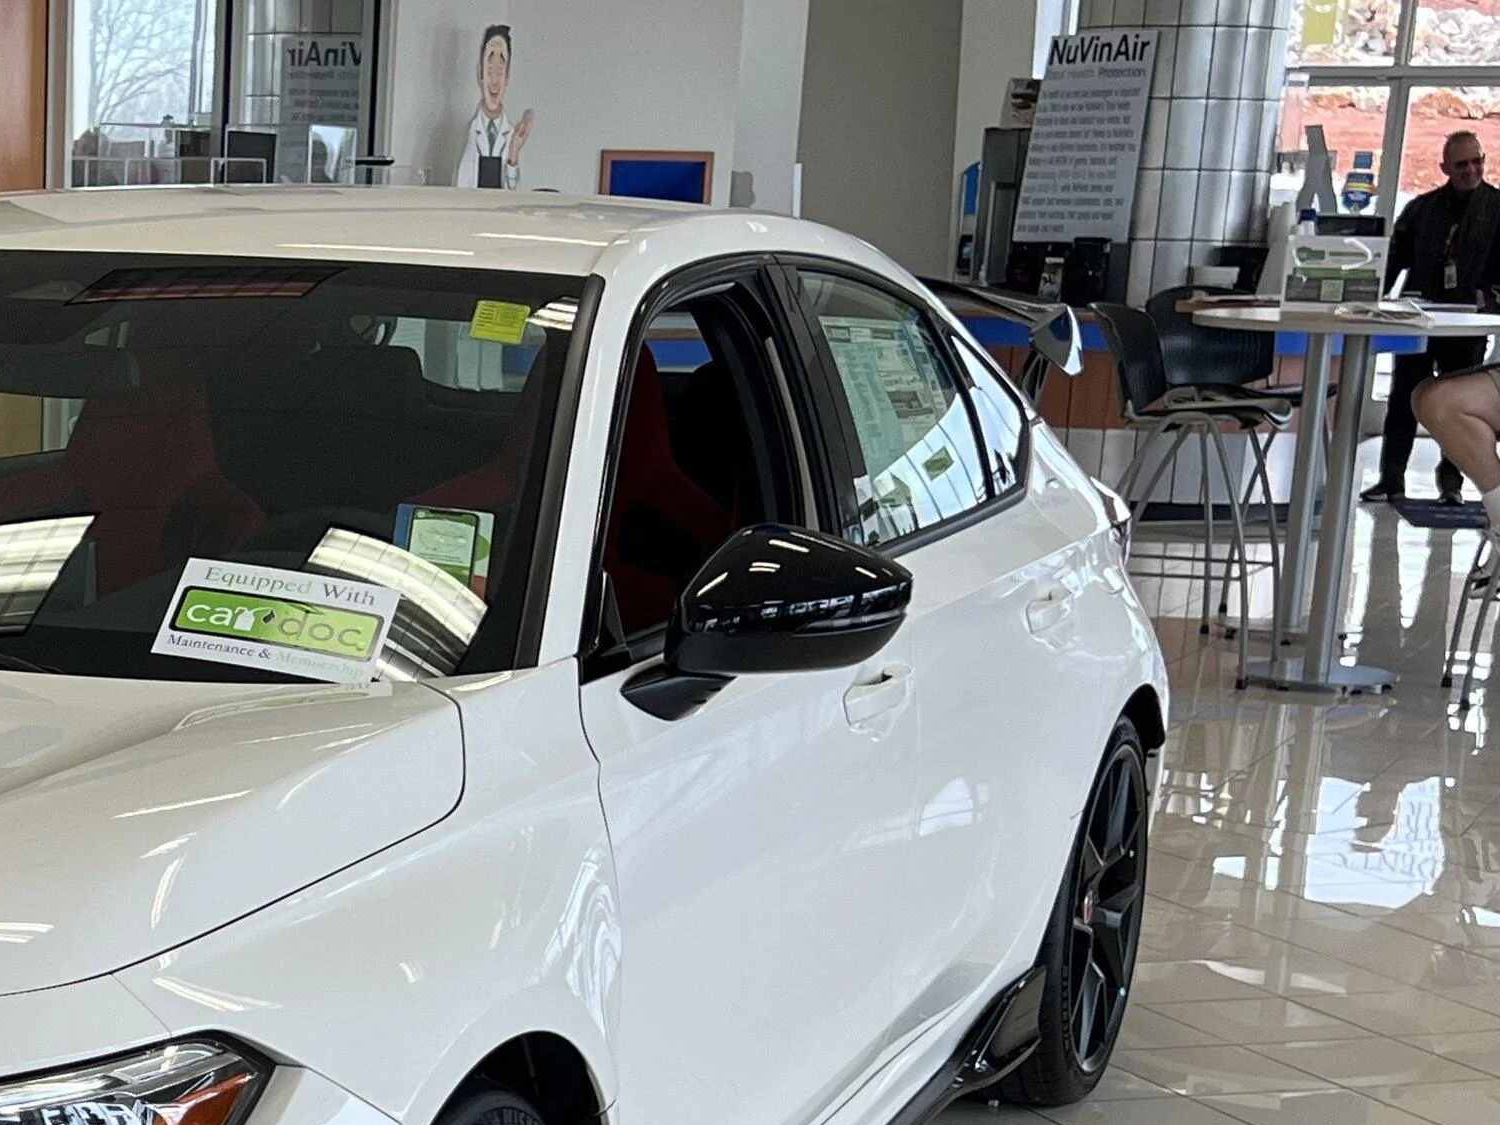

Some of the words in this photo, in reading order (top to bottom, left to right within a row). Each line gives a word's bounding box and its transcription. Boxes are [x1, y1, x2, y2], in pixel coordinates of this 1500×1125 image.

[1049, 33, 1150, 65] NuVinAir
[1099, 67, 1146, 78] Protection
[203, 566, 312, 594] Equipped
[323, 583, 375, 606] With
[167, 633, 255, 657] Maintenance
[258, 649, 271, 660] &
[276, 649, 364, 676] Membership
